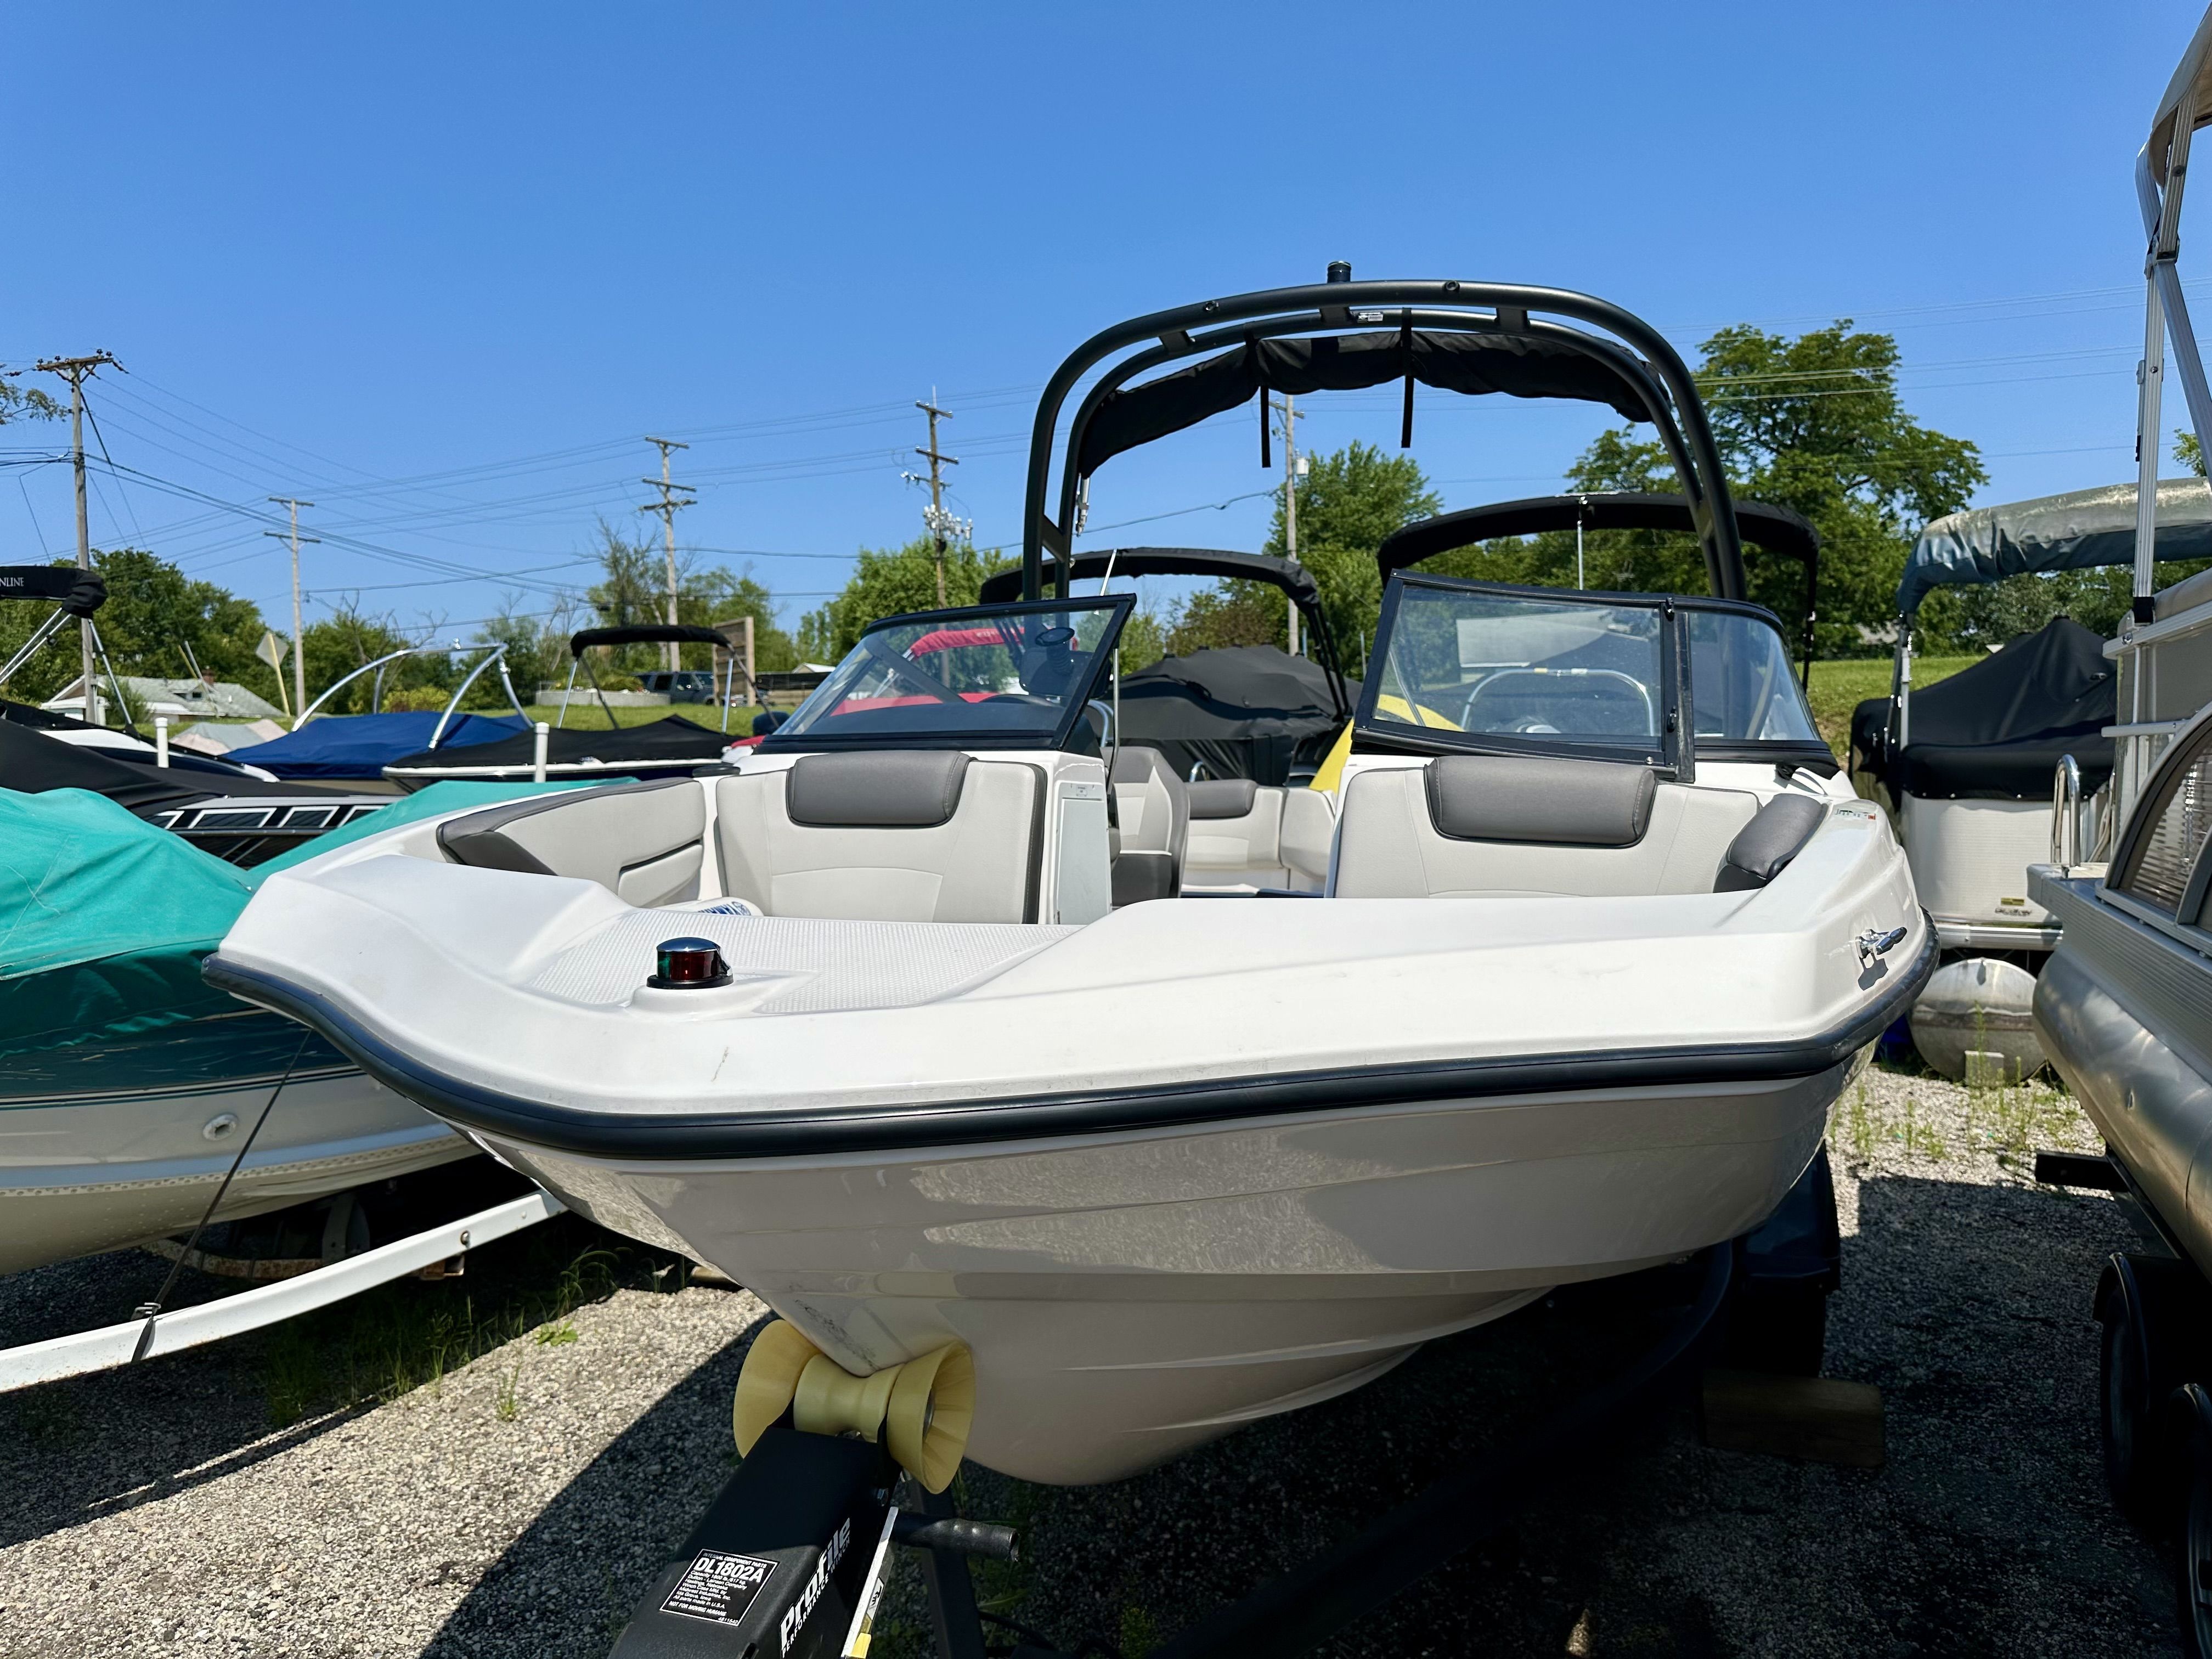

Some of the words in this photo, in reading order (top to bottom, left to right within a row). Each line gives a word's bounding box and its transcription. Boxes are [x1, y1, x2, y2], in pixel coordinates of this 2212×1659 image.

[693, 1558, 764, 1582] DL1802A
[781, 1517, 850, 1651] Profile
[782, 1573, 829, 1658] PERFORMANCE
[830, 1536, 850, 1573] WINCH
